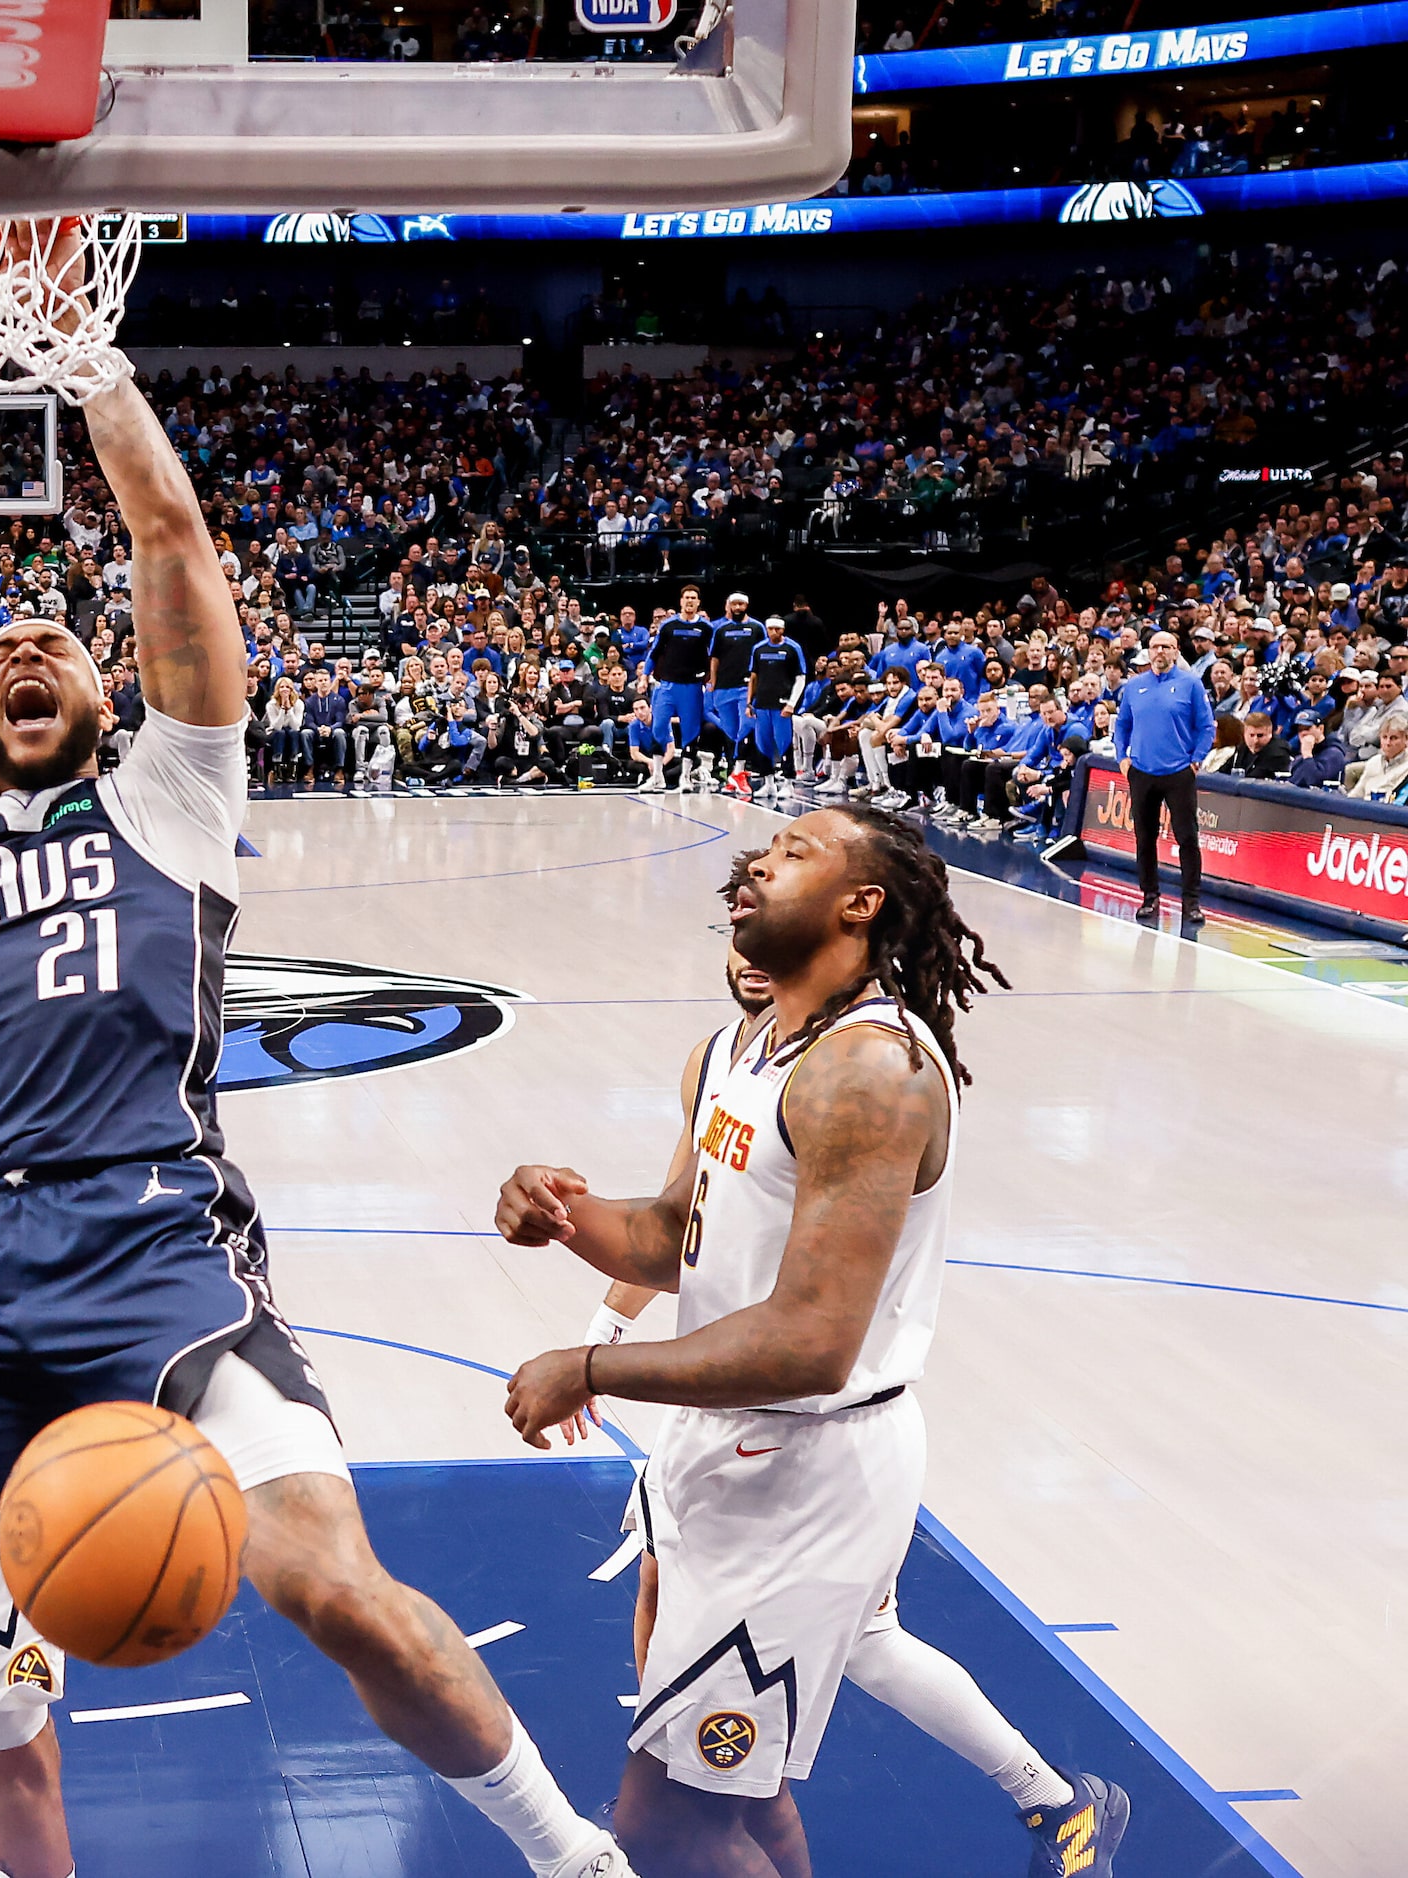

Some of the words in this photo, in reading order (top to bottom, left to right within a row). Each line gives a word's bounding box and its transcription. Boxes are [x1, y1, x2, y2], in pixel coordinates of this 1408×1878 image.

[102, 224, 111, 238] 1
[148, 223, 160, 238] 3
[1269, 468, 1313, 481] ULTRA
[1199, 834, 1240, 857] enerator
[1307, 823, 1408, 898] Jacke
[35, 908, 121, 1002] 21
